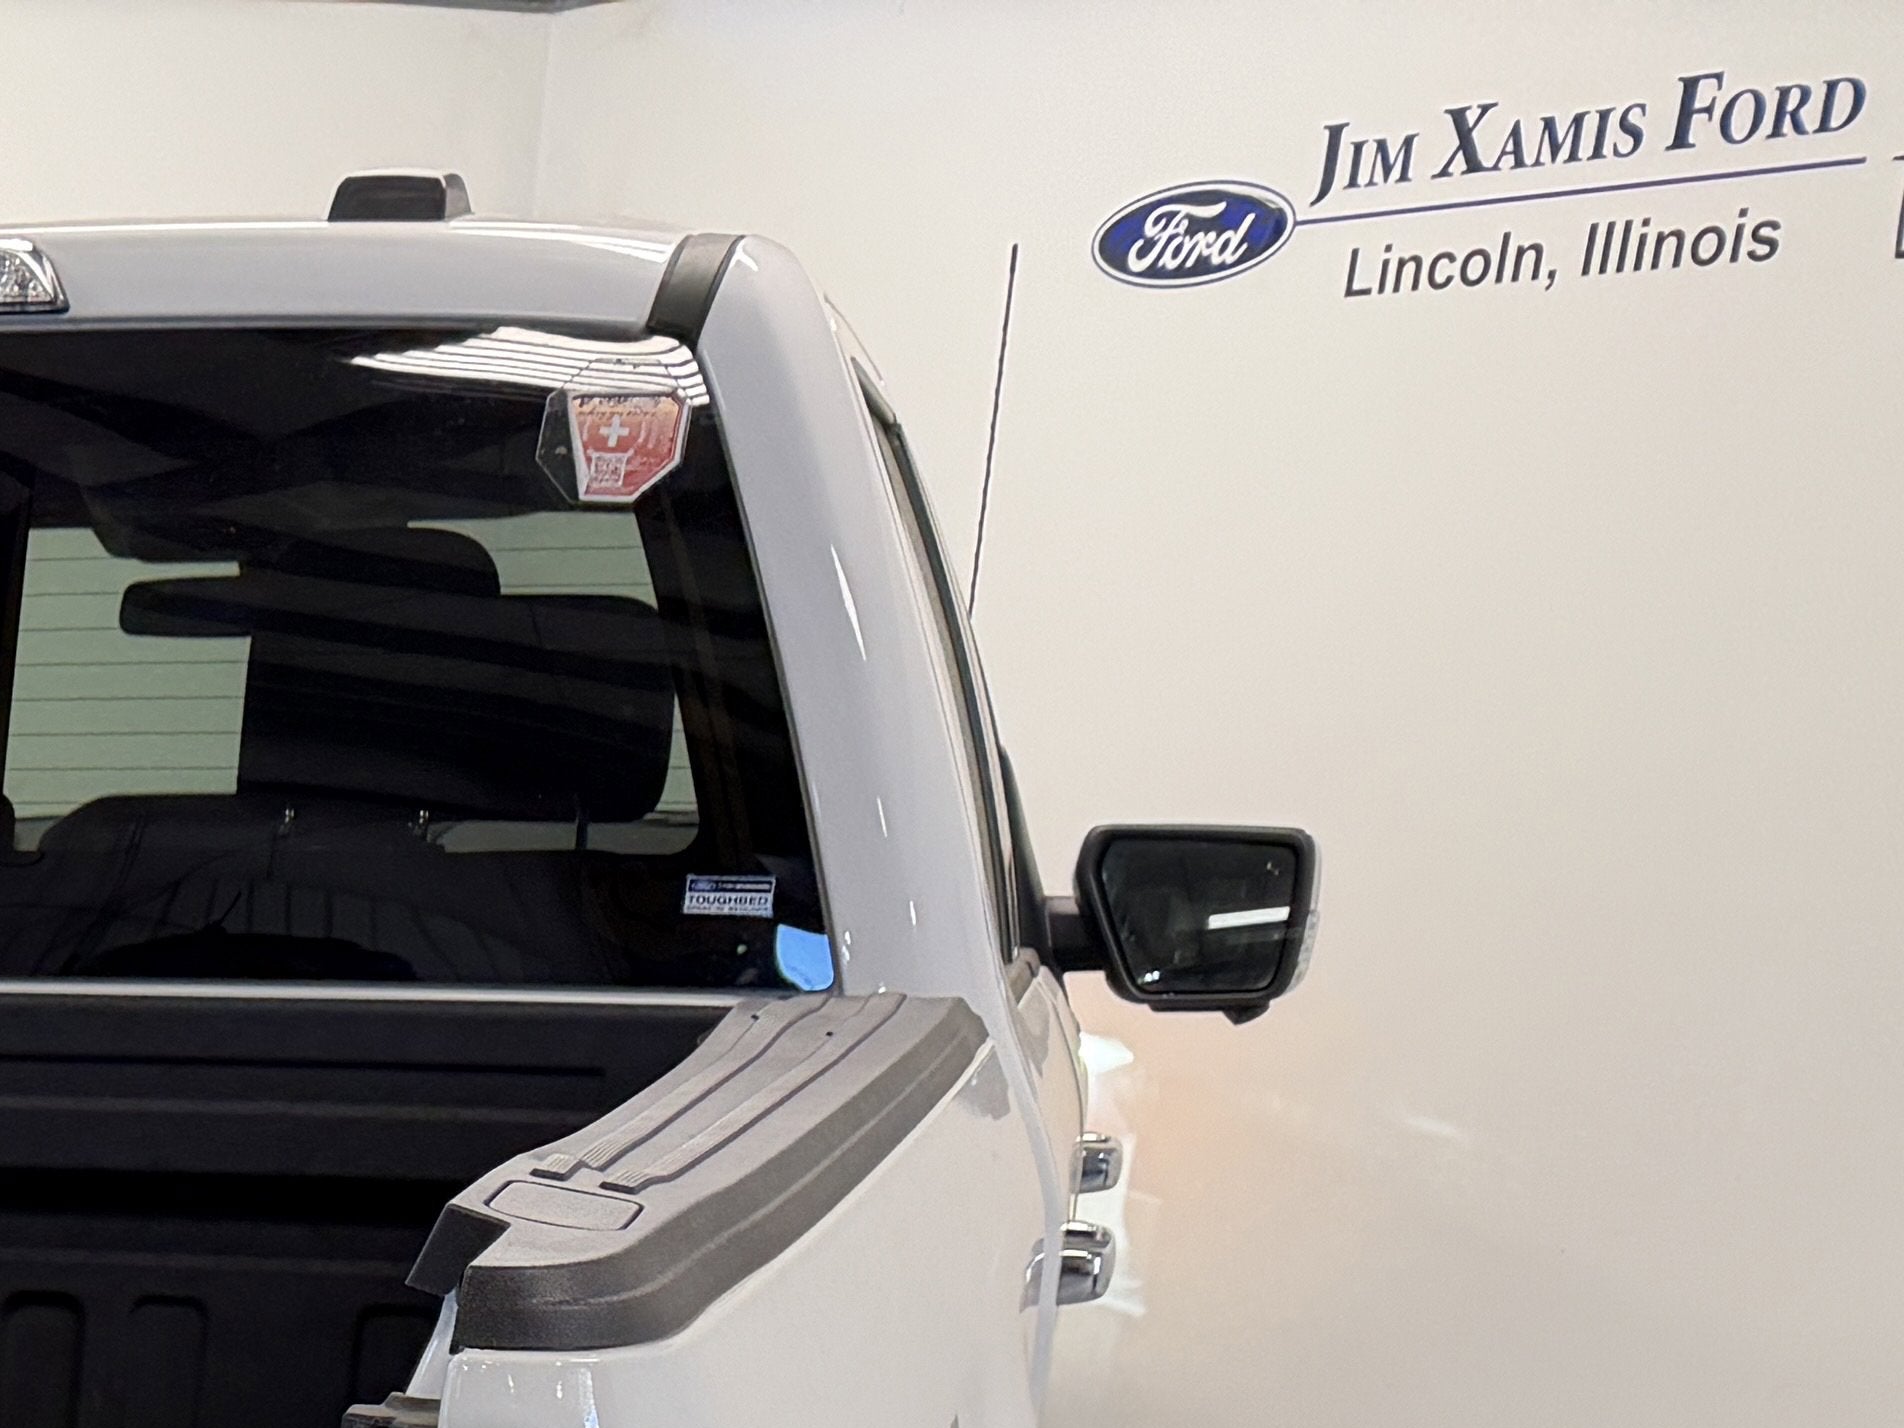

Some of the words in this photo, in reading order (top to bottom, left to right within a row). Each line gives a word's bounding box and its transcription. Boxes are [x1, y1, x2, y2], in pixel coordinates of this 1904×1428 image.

[1309, 122, 1419, 206] JIM
[1432, 101, 1647, 179] XAMIS
[1665, 71, 1868, 151] FORD
[1127, 201, 1256, 273] Ford
[1343, 231, 1558, 299] Lincoln,
[1581, 207, 1783, 277] Illinois
